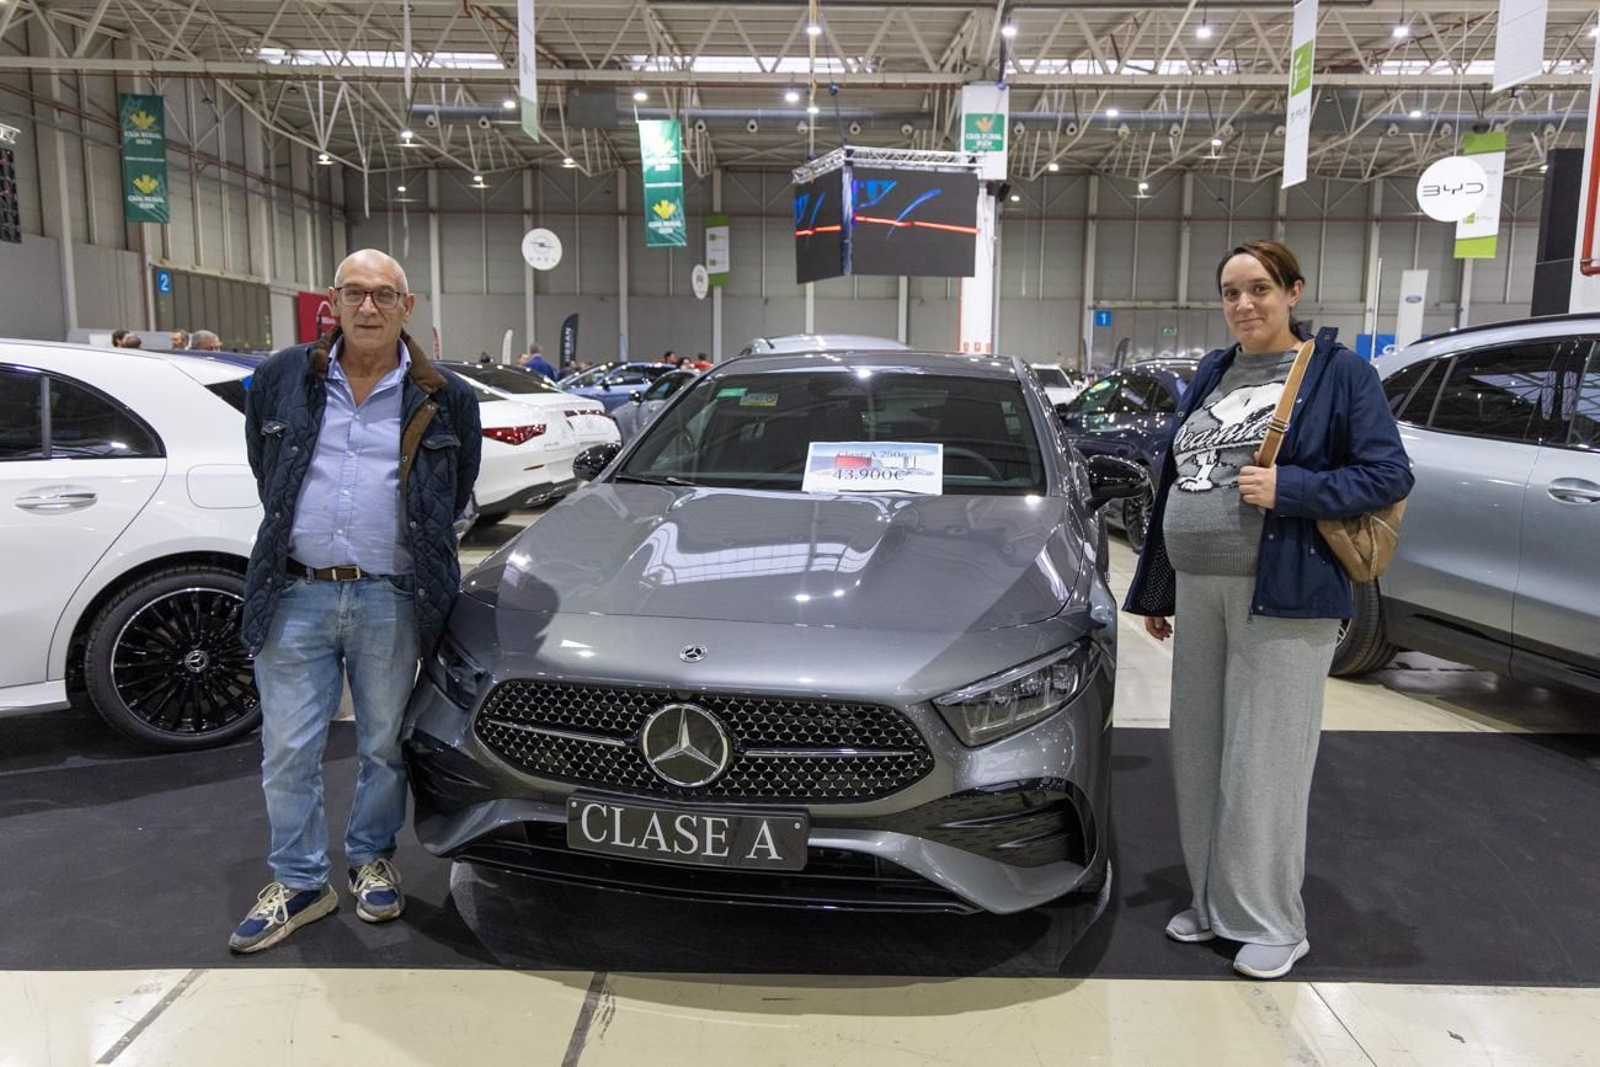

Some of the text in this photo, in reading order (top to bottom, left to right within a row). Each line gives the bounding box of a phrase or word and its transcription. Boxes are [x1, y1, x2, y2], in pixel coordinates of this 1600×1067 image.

[1422, 182, 1484, 197] BYD
[160, 273, 168, 291] 2
[1101, 312, 1107, 325] 1
[581, 803, 783, 860] CLASE A
